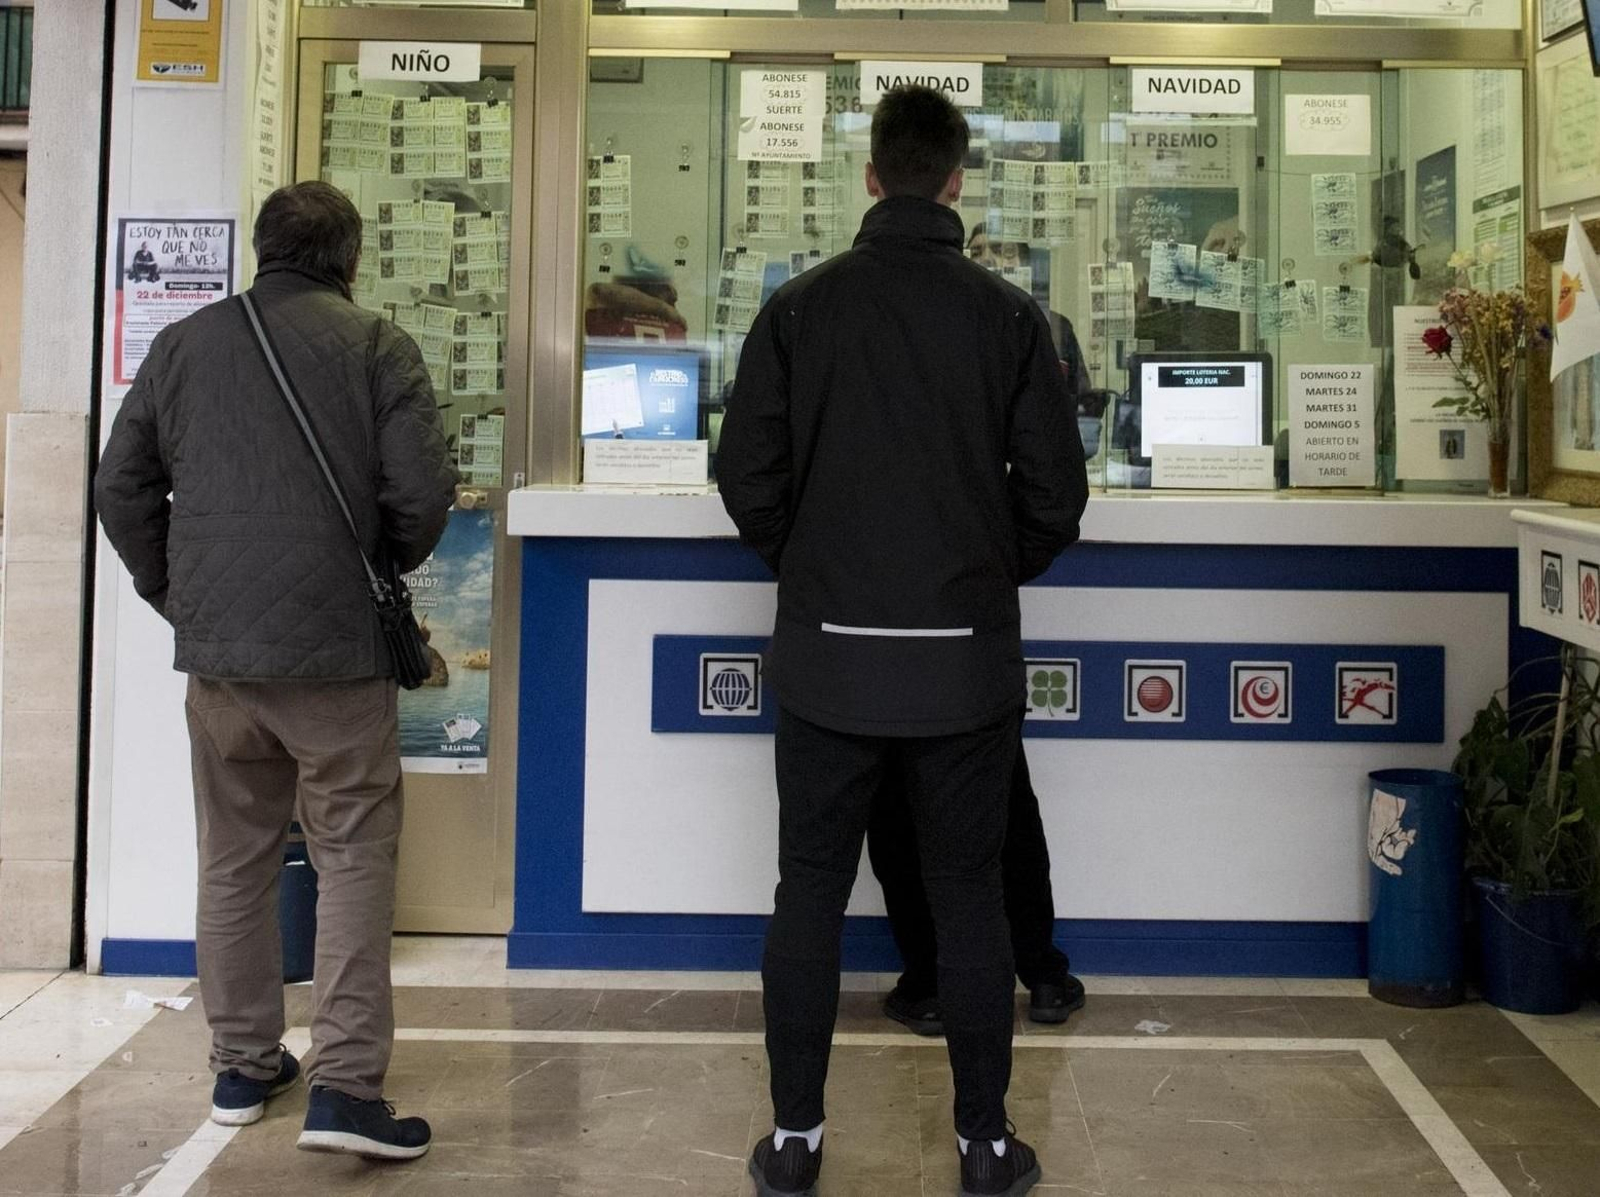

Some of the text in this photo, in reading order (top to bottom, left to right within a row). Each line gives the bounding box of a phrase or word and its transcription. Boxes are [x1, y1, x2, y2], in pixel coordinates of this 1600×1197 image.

[391, 49, 450, 72] NIÑO
[762, 74, 808, 83] ABONESE
[1147, 77, 1241, 94] NAVIDAD
[768, 89, 801, 99] 54.815
[1303, 98, 1348, 109] ABONESE
[766, 105, 803, 115] SUERTE
[1309, 116, 1342, 125] 34.955
[760, 122, 805, 132] ABONESE
[766, 138, 799, 147] 17.556
[1146, 132, 1218, 148] PREMIO
[129, 226, 162, 239] ESTOY
[192, 226, 226, 240] CERCA
[161, 240, 208, 254] QUE NO
[174, 252, 218, 267] ME VES
[136, 291, 213, 300] 22 de diciembre
[1300, 371, 1362, 380] DOMINGO 22
[1184, 377, 1219, 385] 20,00 EUR
[1305, 387, 1357, 396] MARTES 24
[1306, 404, 1357, 412] MARTES 31
[1304, 420, 1361, 429] DOMINGO 5
[1305, 437, 1359, 446] ABIERTO EN
[1304, 452, 1361, 461] HORARIO DE
[1317, 467, 1348, 477] TARDE
